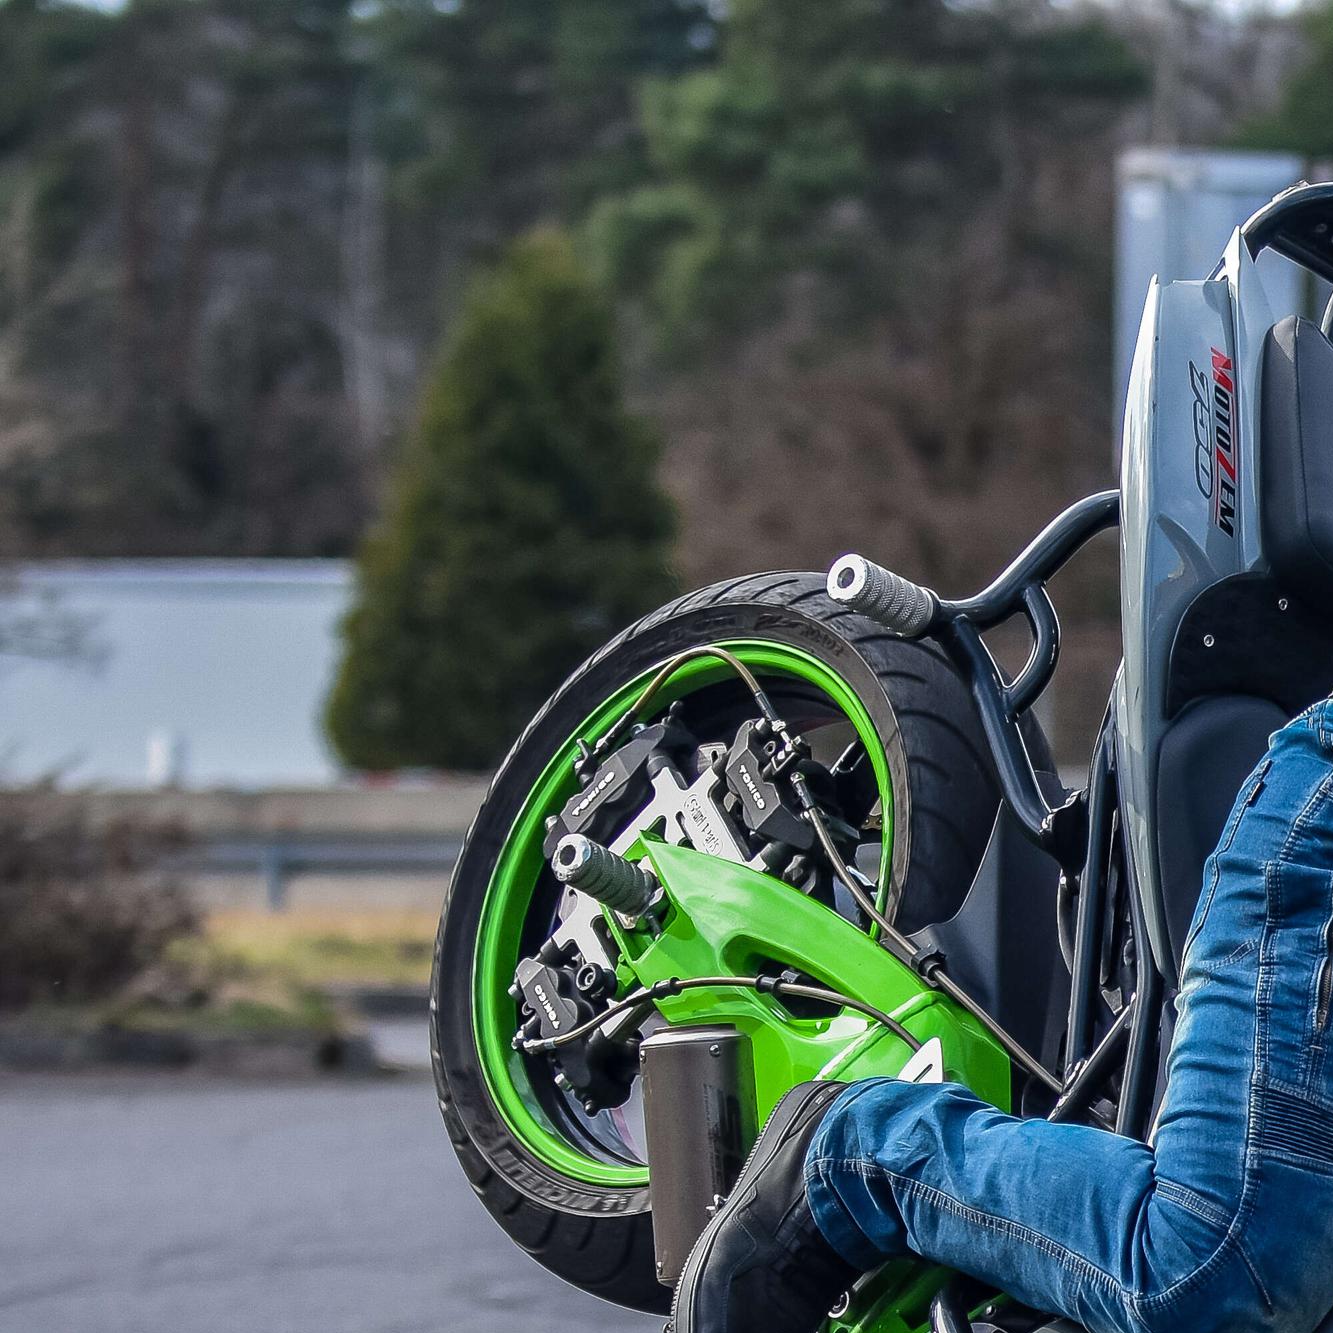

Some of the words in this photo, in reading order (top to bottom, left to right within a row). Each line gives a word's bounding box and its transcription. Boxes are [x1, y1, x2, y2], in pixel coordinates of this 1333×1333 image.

[1188, 360, 1213, 500] 750
[1210, 346, 1236, 538] MOTOZEM
[739, 764, 766, 810] TOKICO
[534, 984, 560, 1029] TOKICO
